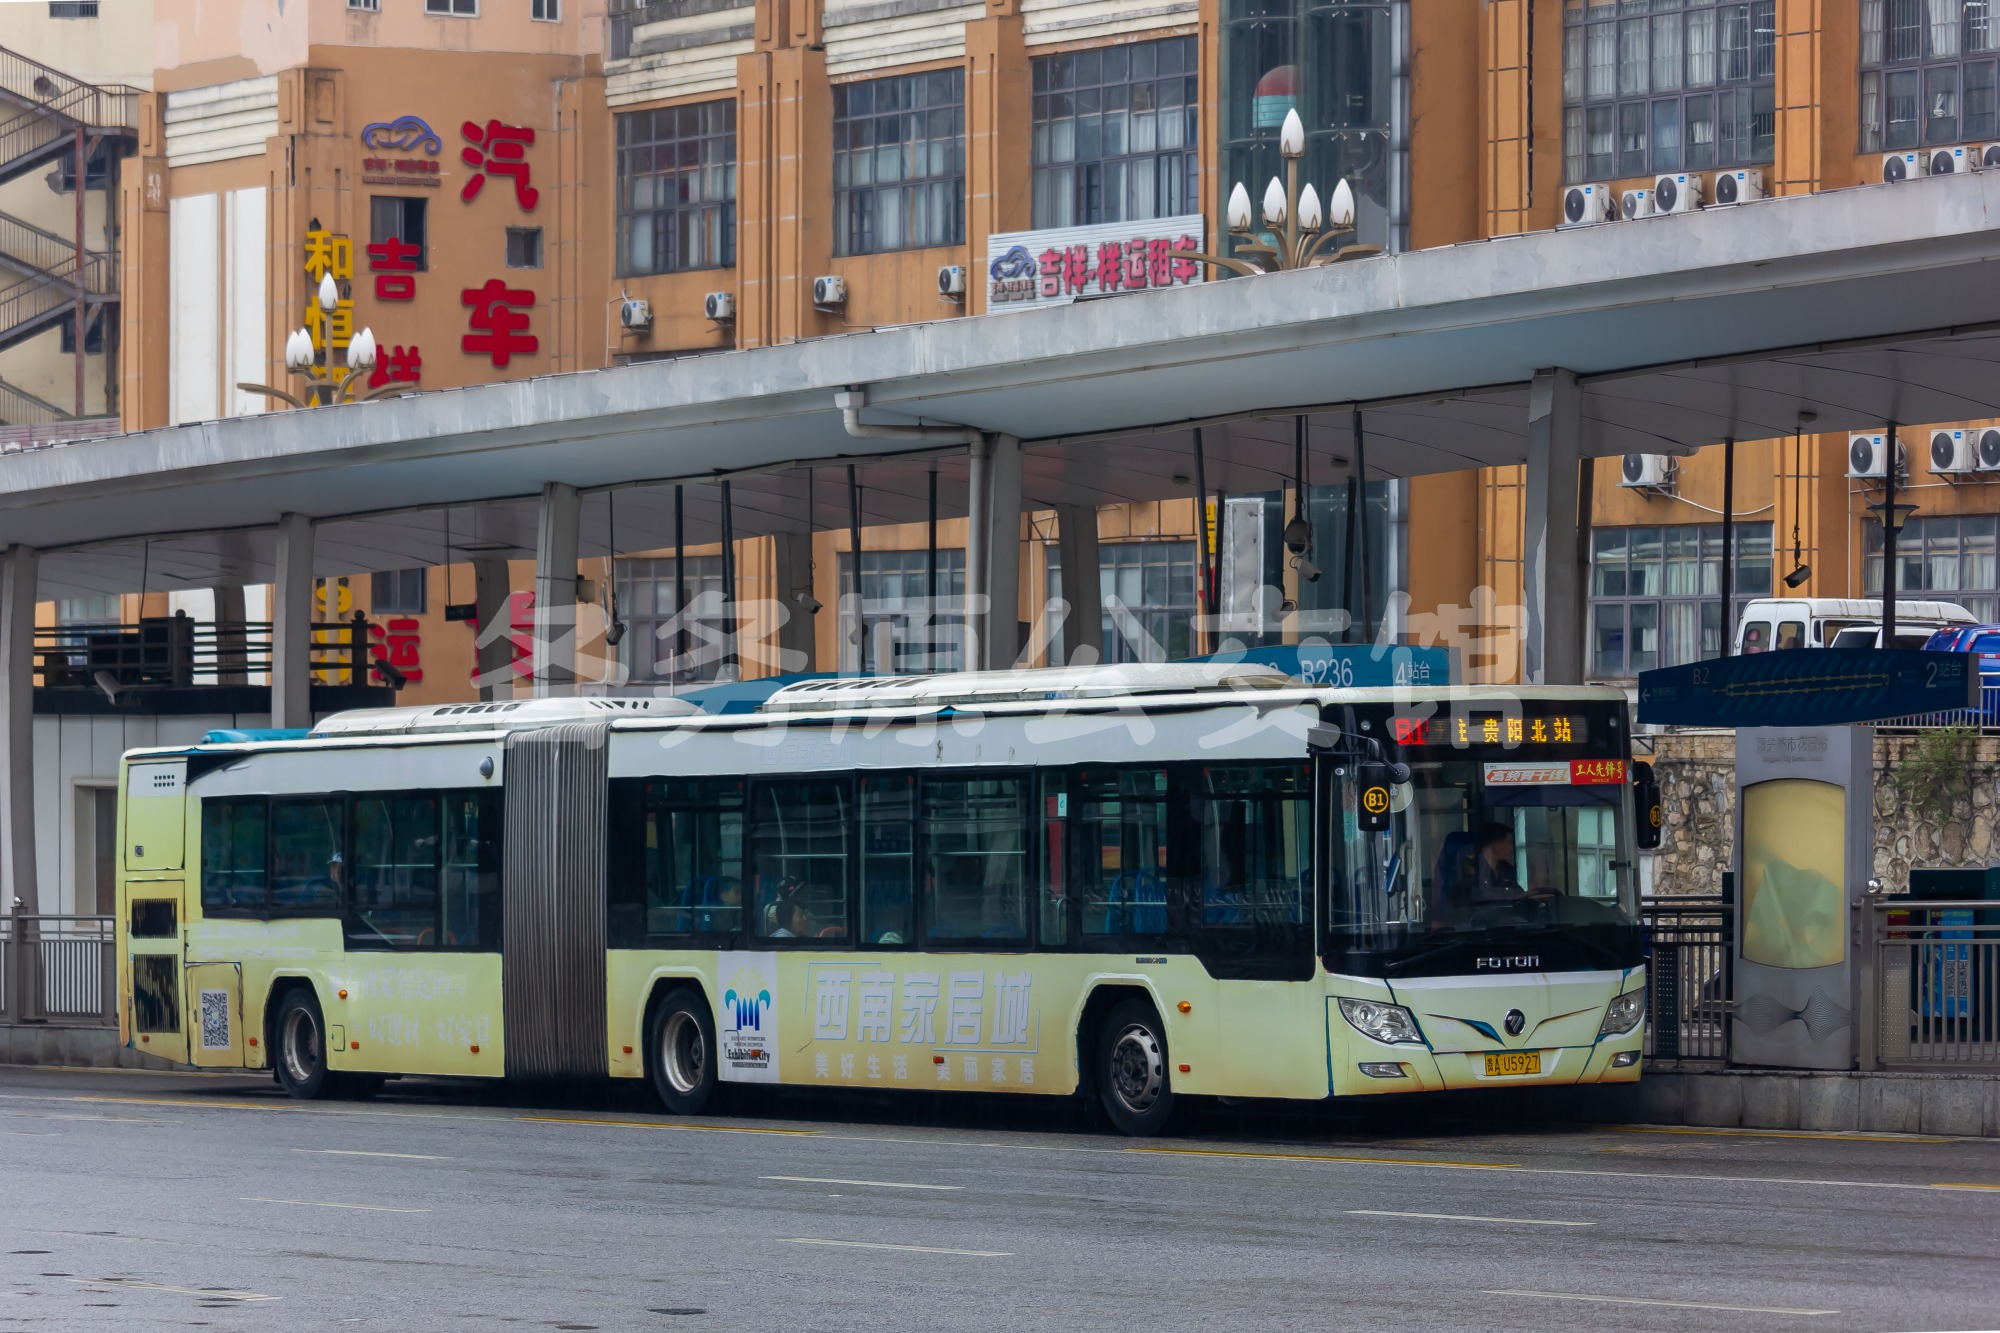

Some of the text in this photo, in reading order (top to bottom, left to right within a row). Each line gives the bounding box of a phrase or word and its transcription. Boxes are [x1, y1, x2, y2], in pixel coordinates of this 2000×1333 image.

[461, 118, 539, 367] 汽车
[304, 230, 355, 407] 和恒
[1301, 658, 1353, 687] B236
[1693, 667, 1710, 685] B2
[1575, 761, 1622, 779] 工人先锋号
[1368, 792, 1384, 807] B1
[1476, 955, 1540, 969] FOTON
[813, 969, 1033, 1045] 西南家居城
[815, 1052, 1034, 1085] 美好生活 美丽家居
